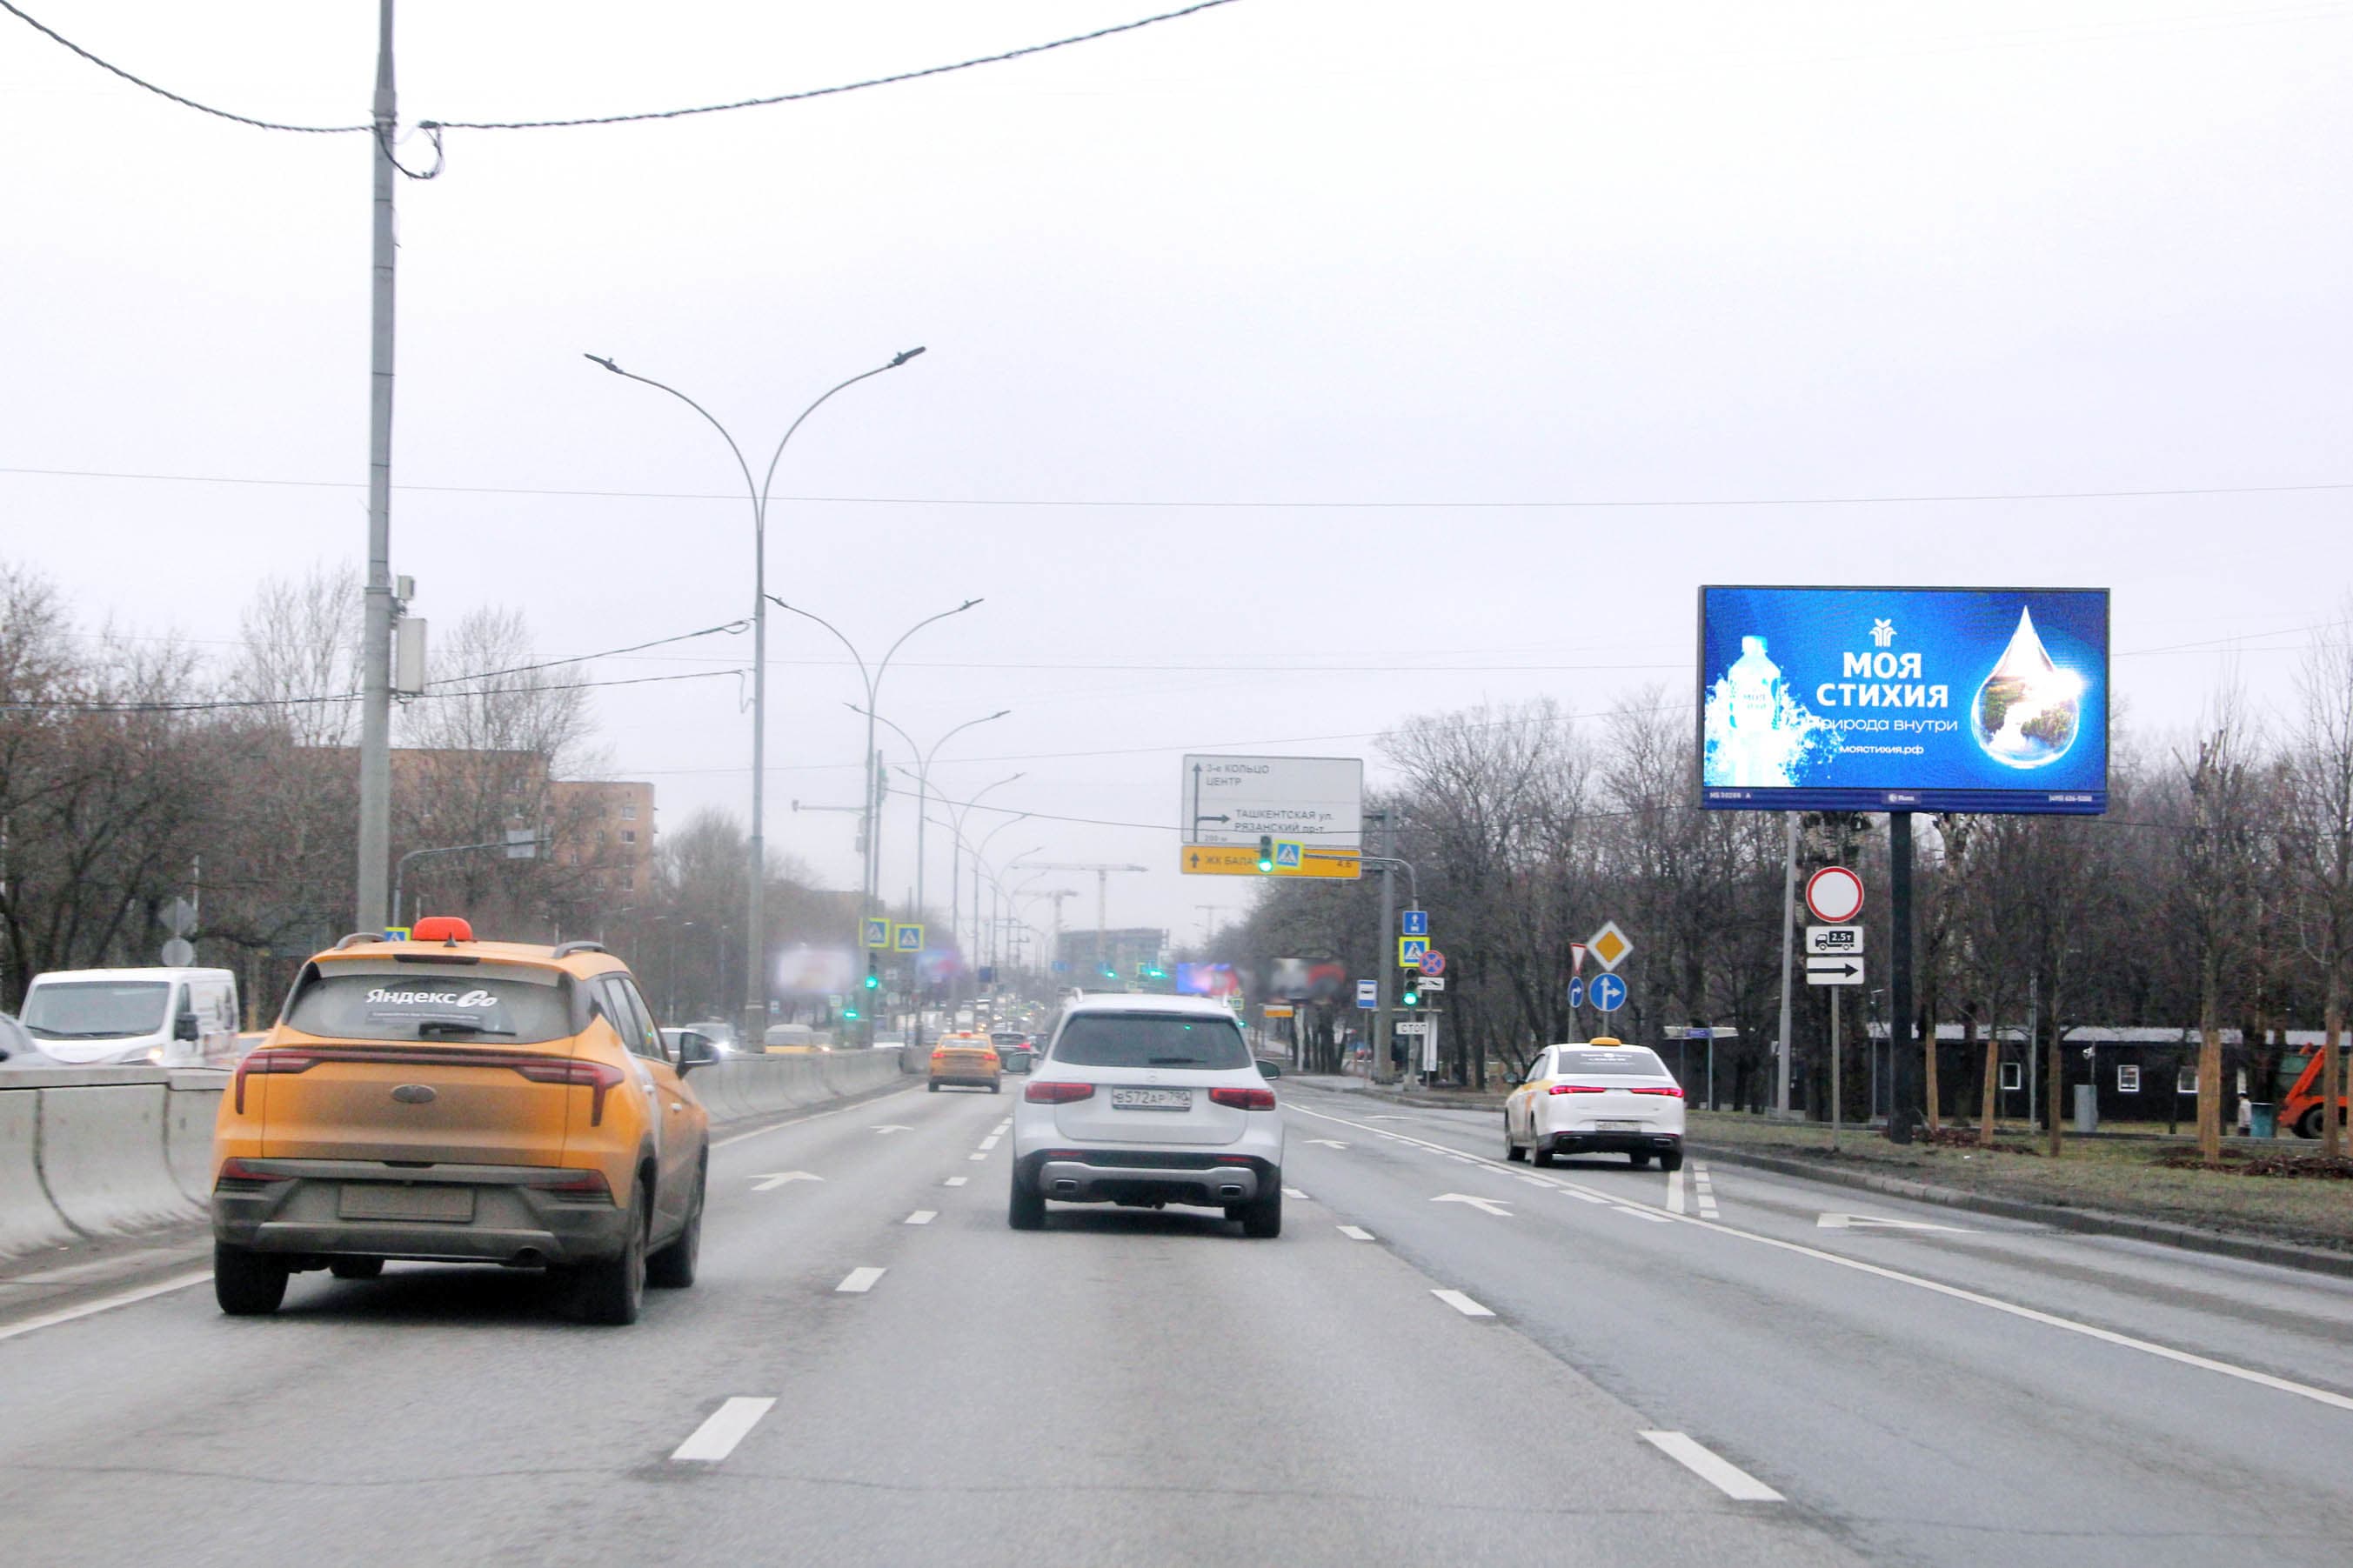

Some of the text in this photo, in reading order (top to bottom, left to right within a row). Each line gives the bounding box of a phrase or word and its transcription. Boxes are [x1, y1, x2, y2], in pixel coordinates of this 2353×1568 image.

[1842, 651, 1922, 679] МОЯ
[1816, 683, 1949, 708] СТИХИЯ
[1894, 719, 1958, 733] внутри
[1839, 744, 1924, 755] моястихия.рф
[1224, 764, 1271, 774] КОЛЬЦО
[1206, 777, 1242, 786] ЦЕНТР
[1235, 809, 1316, 820] ТАШКЕНТСКАЯ
[1233, 822, 1300, 832] РЯЗАНСКИЙ
[365, 989, 498, 1007] Яндекс Go
[1401, 1024, 1427, 1033] СТОП
